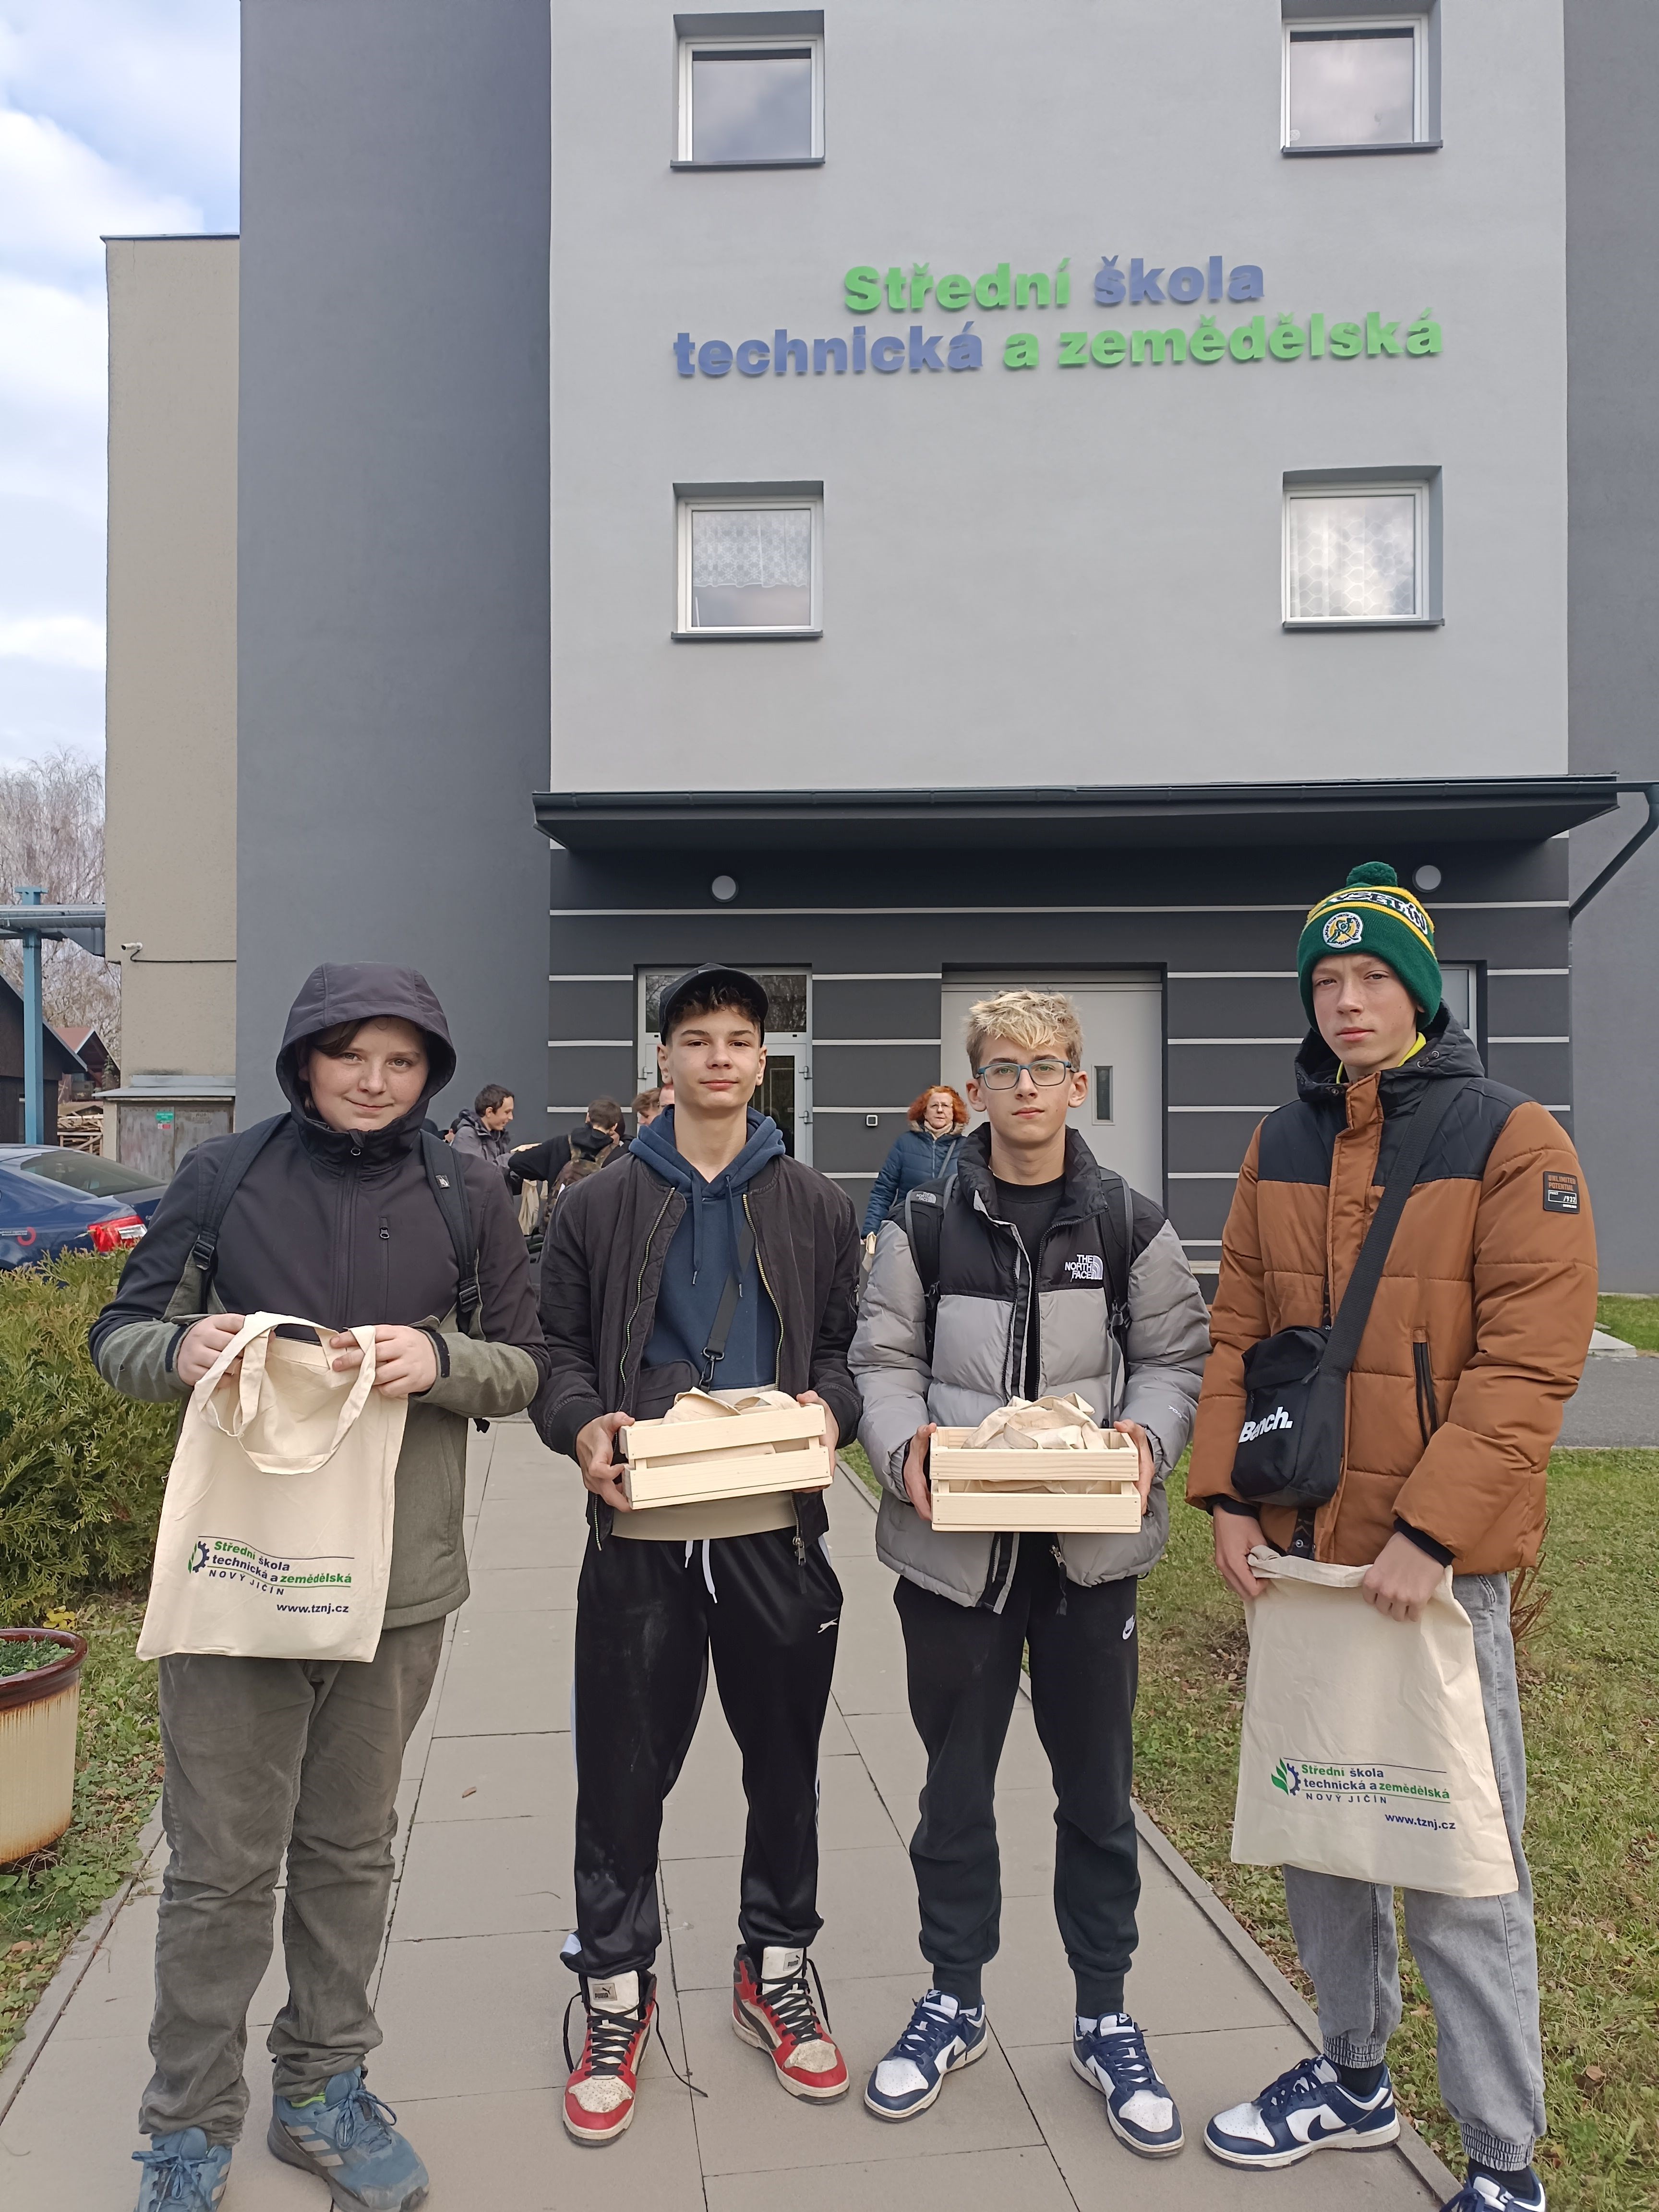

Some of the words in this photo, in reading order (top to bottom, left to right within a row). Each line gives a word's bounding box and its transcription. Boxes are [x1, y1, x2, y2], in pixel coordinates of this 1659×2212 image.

[844, 258, 1071, 311] Střední
[1094, 255, 1264, 305] škola
[673, 321, 983, 374] technická
[1003, 332, 1039, 368] a
[1058, 307, 1443, 364] zemědělská
[1076, 1254, 1094, 1263] THE
[1065, 1262, 1092, 1272] NORTH
[1071, 1270, 1092, 1279] FACE
[1168, 1405, 1182, 1418] 700
[1238, 1406, 1294, 1443] Bench.
[214, 1540, 256, 1560] Střední
[258, 1556, 290, 1571] škola
[209, 1569, 246, 1581] NOVÝ
[212, 1554, 267, 1579] technická
[270, 1574, 278, 1582] a
[280, 1573, 352, 1584] zemědělská
[276, 1603, 349, 1614] www.tznj.cz
[1301, 1764, 1345, 1777] Střední
[1349, 1767, 1384, 1778] škola
[1304, 1778, 1366, 1790] technická
[1370, 1781, 1377, 1790] a
[1379, 1782, 1450, 1799] zemědělská
[1306, 1792, 1342, 1802] NOVÝ
[1348, 1794, 1387, 1804] JIČÍN
[1384, 1814, 1456, 1831] www.tznj.cz
